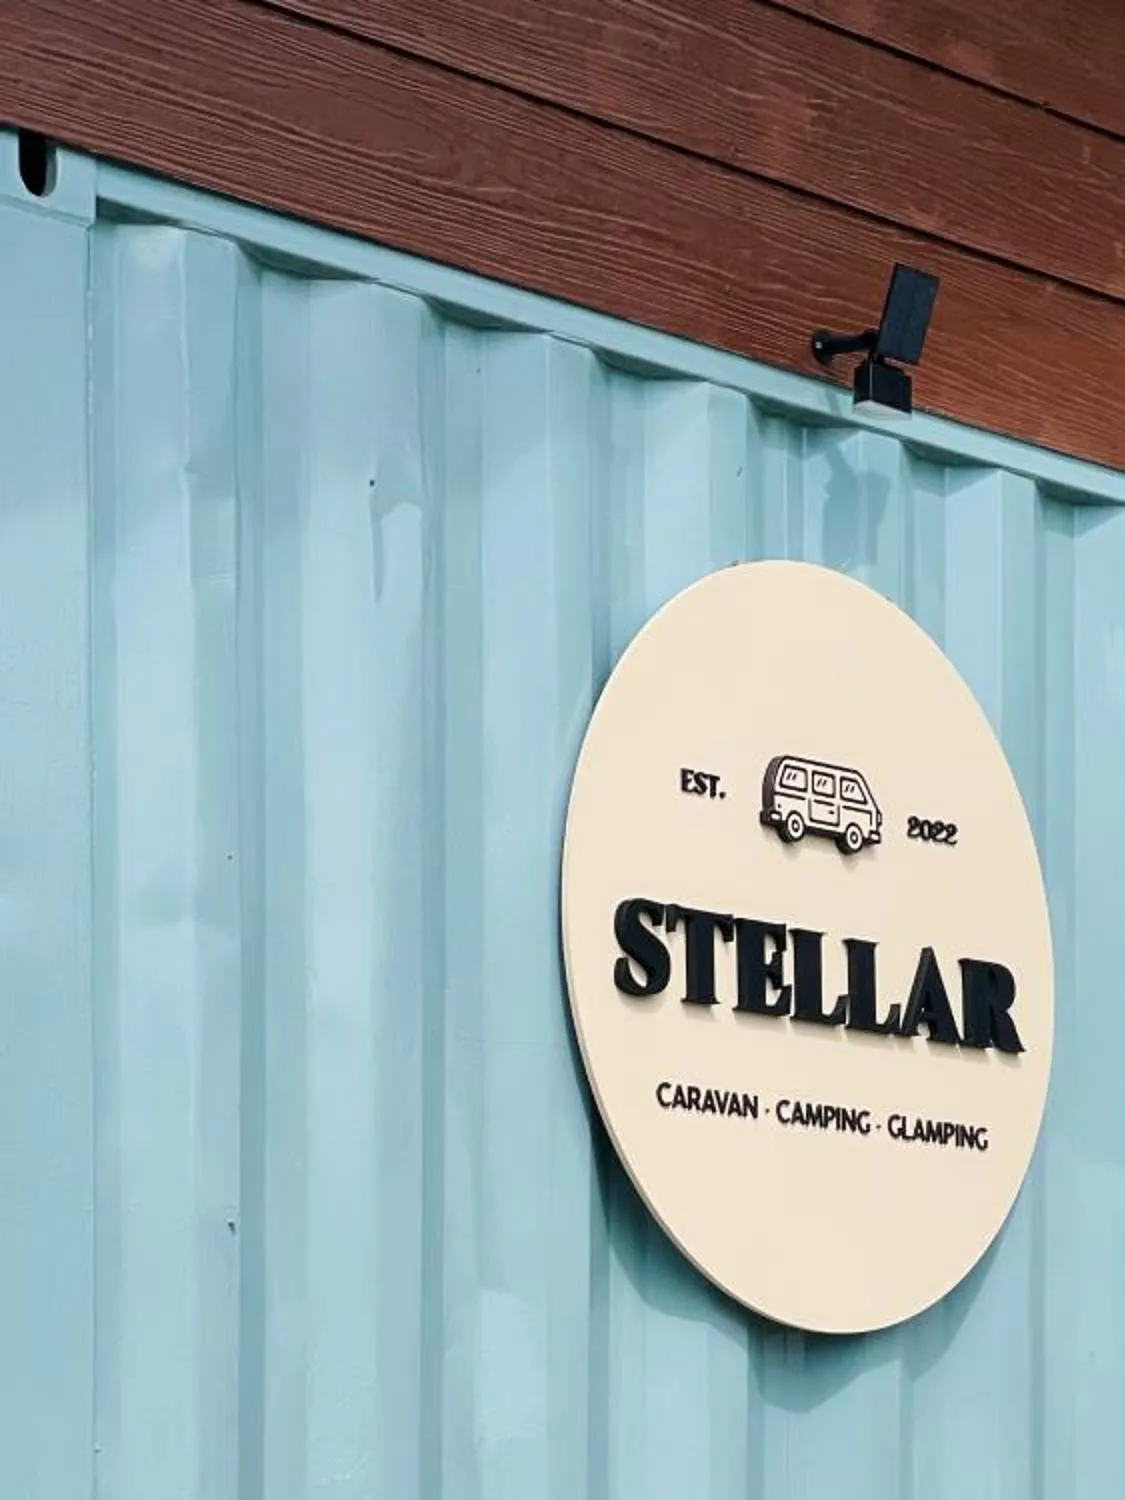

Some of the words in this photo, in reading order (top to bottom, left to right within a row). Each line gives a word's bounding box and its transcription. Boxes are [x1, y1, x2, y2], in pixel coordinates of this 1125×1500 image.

[681, 768, 726, 799] EST.
[907, 816, 958, 847] 2022
[614, 898, 1026, 1054] STELLAR
[656, 1082, 759, 1120] CARAVAN
[776, 1100, 871, 1136] CAMPING
[888, 1115, 989, 1152] GLAMPING
